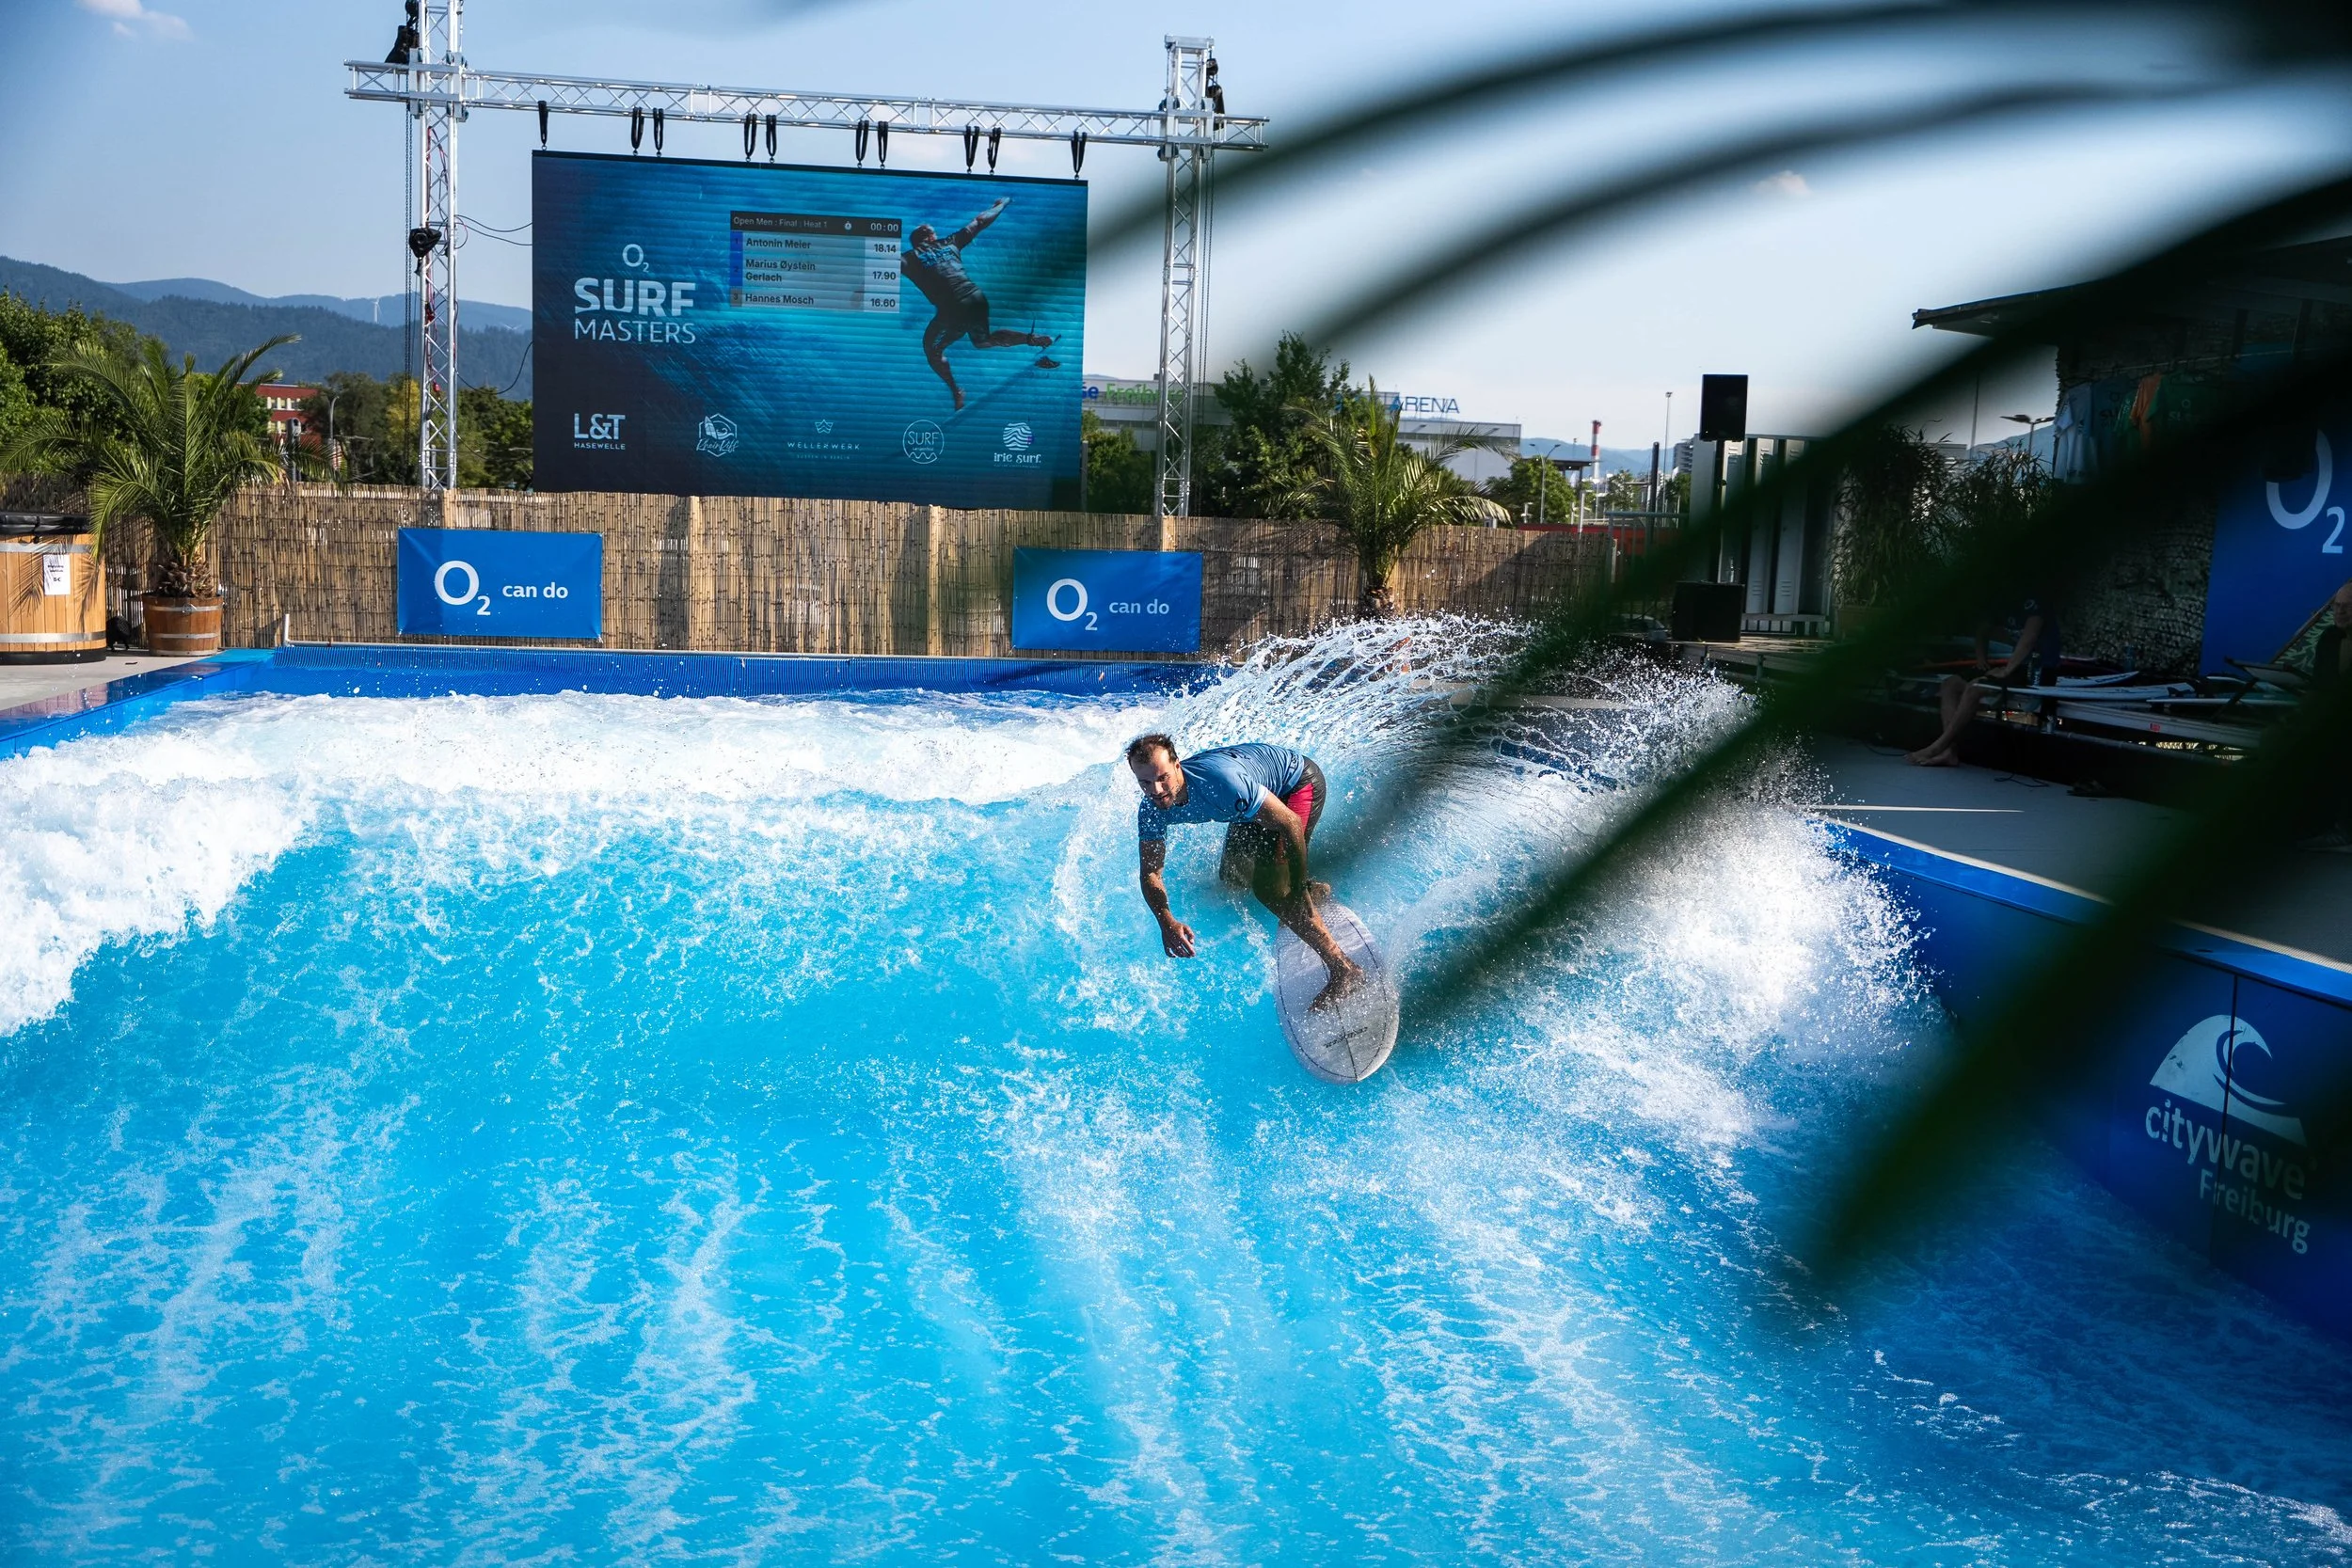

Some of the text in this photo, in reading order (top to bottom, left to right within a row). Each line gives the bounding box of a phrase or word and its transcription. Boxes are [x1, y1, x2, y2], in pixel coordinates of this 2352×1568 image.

[734, 216, 755, 227] Open
[755, 217, 773, 226] Men
[779, 218, 798, 228] Final
[803, 220, 822, 229] Heat
[746, 238, 783, 248] Antonin
[785, 239, 812, 249] Meier
[874, 244, 897, 253] 18.14
[745, 259, 777, 269] Marius
[780, 260, 816, 272] Øystein
[745, 271, 897, 282] Gerlach 17.90
[574, 277, 696, 317] SURF
[745, 293, 781, 304] Hannes
[783, 294, 815, 306] Mosch
[871, 298, 896, 308] 16.60
[574, 318, 696, 344] MASTERS
[1390, 395, 1460, 414] ARENA
[574, 413, 626, 440] L&T
[907, 430, 940, 445] SURF
[574, 442, 626, 451] HASEWELLE
[993, 451, 1013, 463] irie
[434, 560, 568, 616] O2 can do
[1046, 578, 1169, 631] O2 can do
[2145, 1099, 2306, 1200] citywave
[2199, 1168, 2311, 1255] Freiburg
